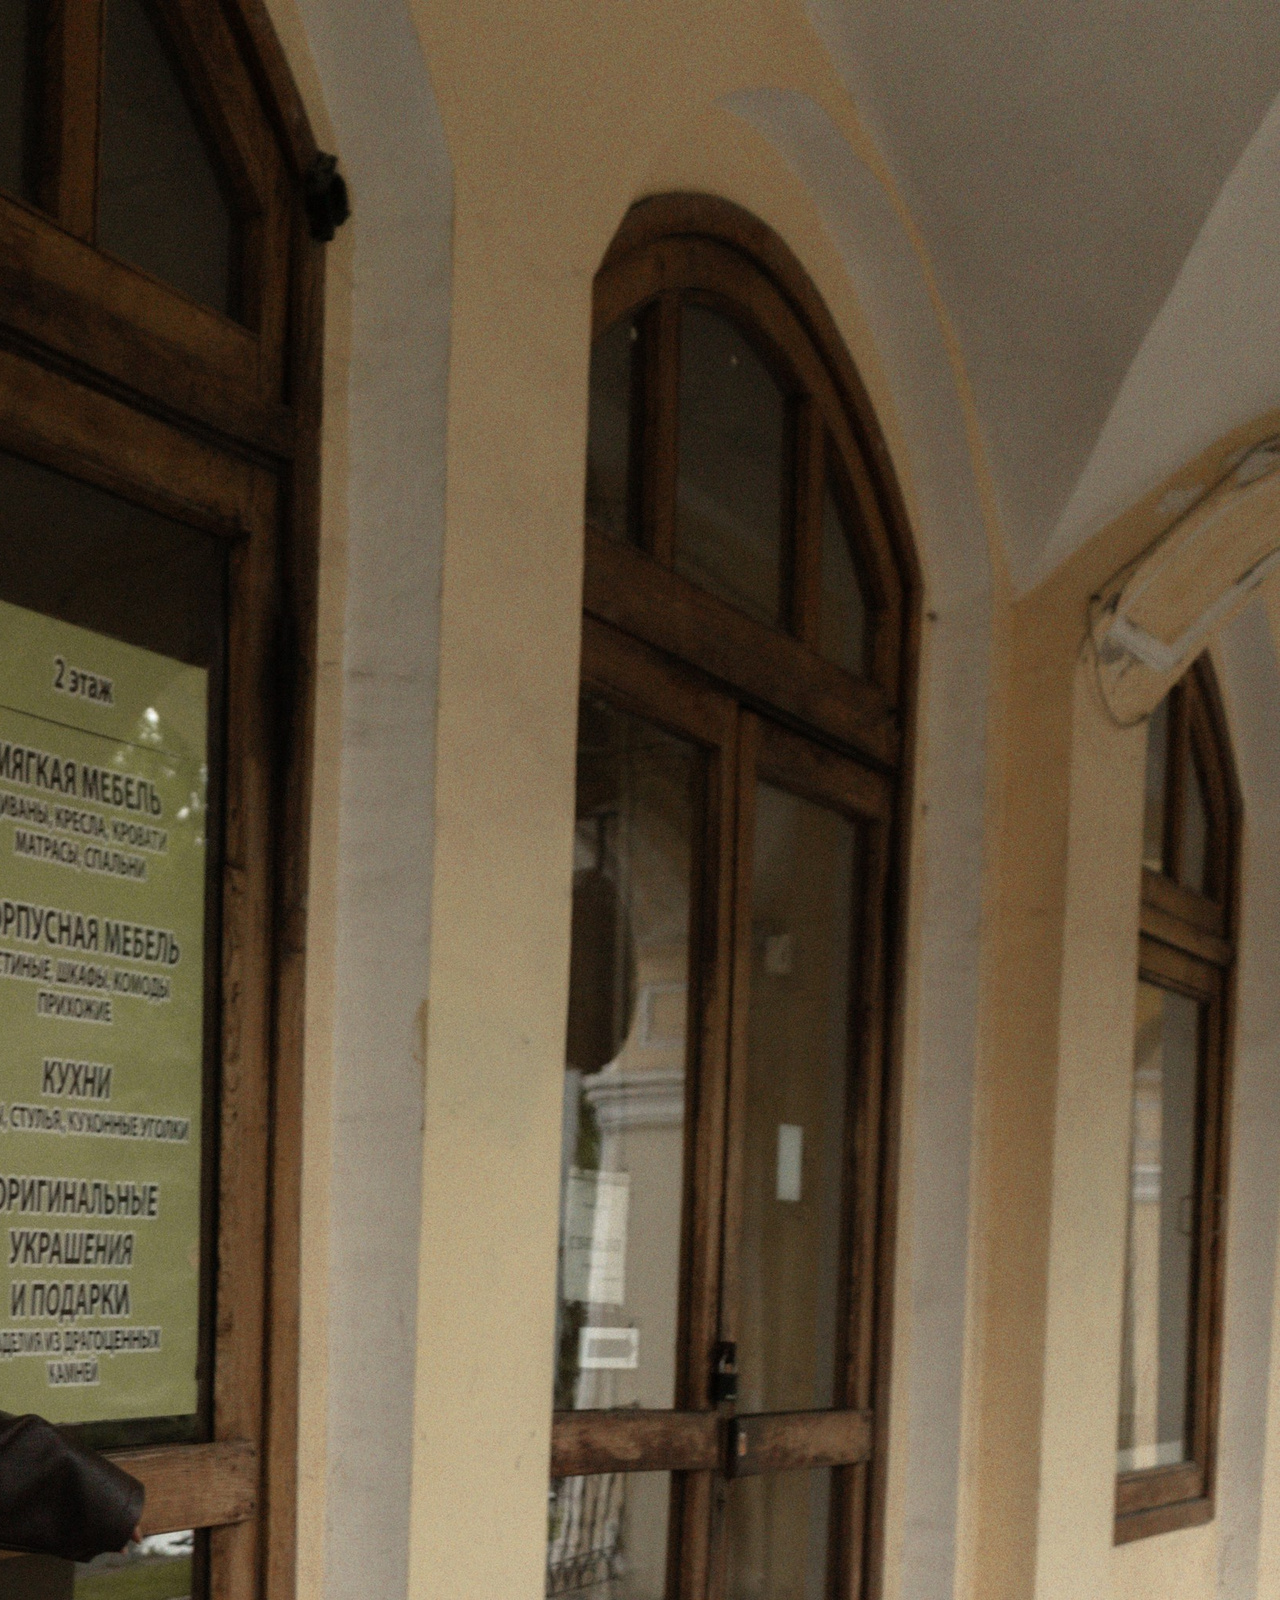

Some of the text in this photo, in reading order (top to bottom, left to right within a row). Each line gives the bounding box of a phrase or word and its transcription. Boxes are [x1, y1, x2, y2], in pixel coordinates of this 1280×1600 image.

[54, 657, 114, 703] 2 этаж
[82, 765, 162, 816] МЕБЕЛЬ
[55, 805, 107, 840] КРЕСЛА,
[112, 818, 167, 851] КРОВАТИ
[84, 846, 146, 879] СПАЛЬНИ
[104, 922, 179, 965] МЕБЕЛЬ
[56, 960, 111, 991] ШКАФЫ,
[112, 971, 169, 1001] КОМОДЫ
[37, 991, 112, 1022] ПРИХОЖИЕ
[42, 1060, 112, 1099] КУХНИ
[10, 1105, 66, 1134] СТУЛЬЯ,
[68, 1110, 137, 1137] КУХОННЫЕ
[139, 1116, 189, 1141] УГОЛКИ
[9, 1231, 134, 1265] УКРАШЕНИЯ
[10, 1283, 131, 1322] И ПОДАРКИ
[45, 1331, 61, 1351] ИЗ
[64, 1329, 160, 1355] ДРАГОЦЕННЫХ
[48, 1359, 99, 1384] КАМНЕЙ
